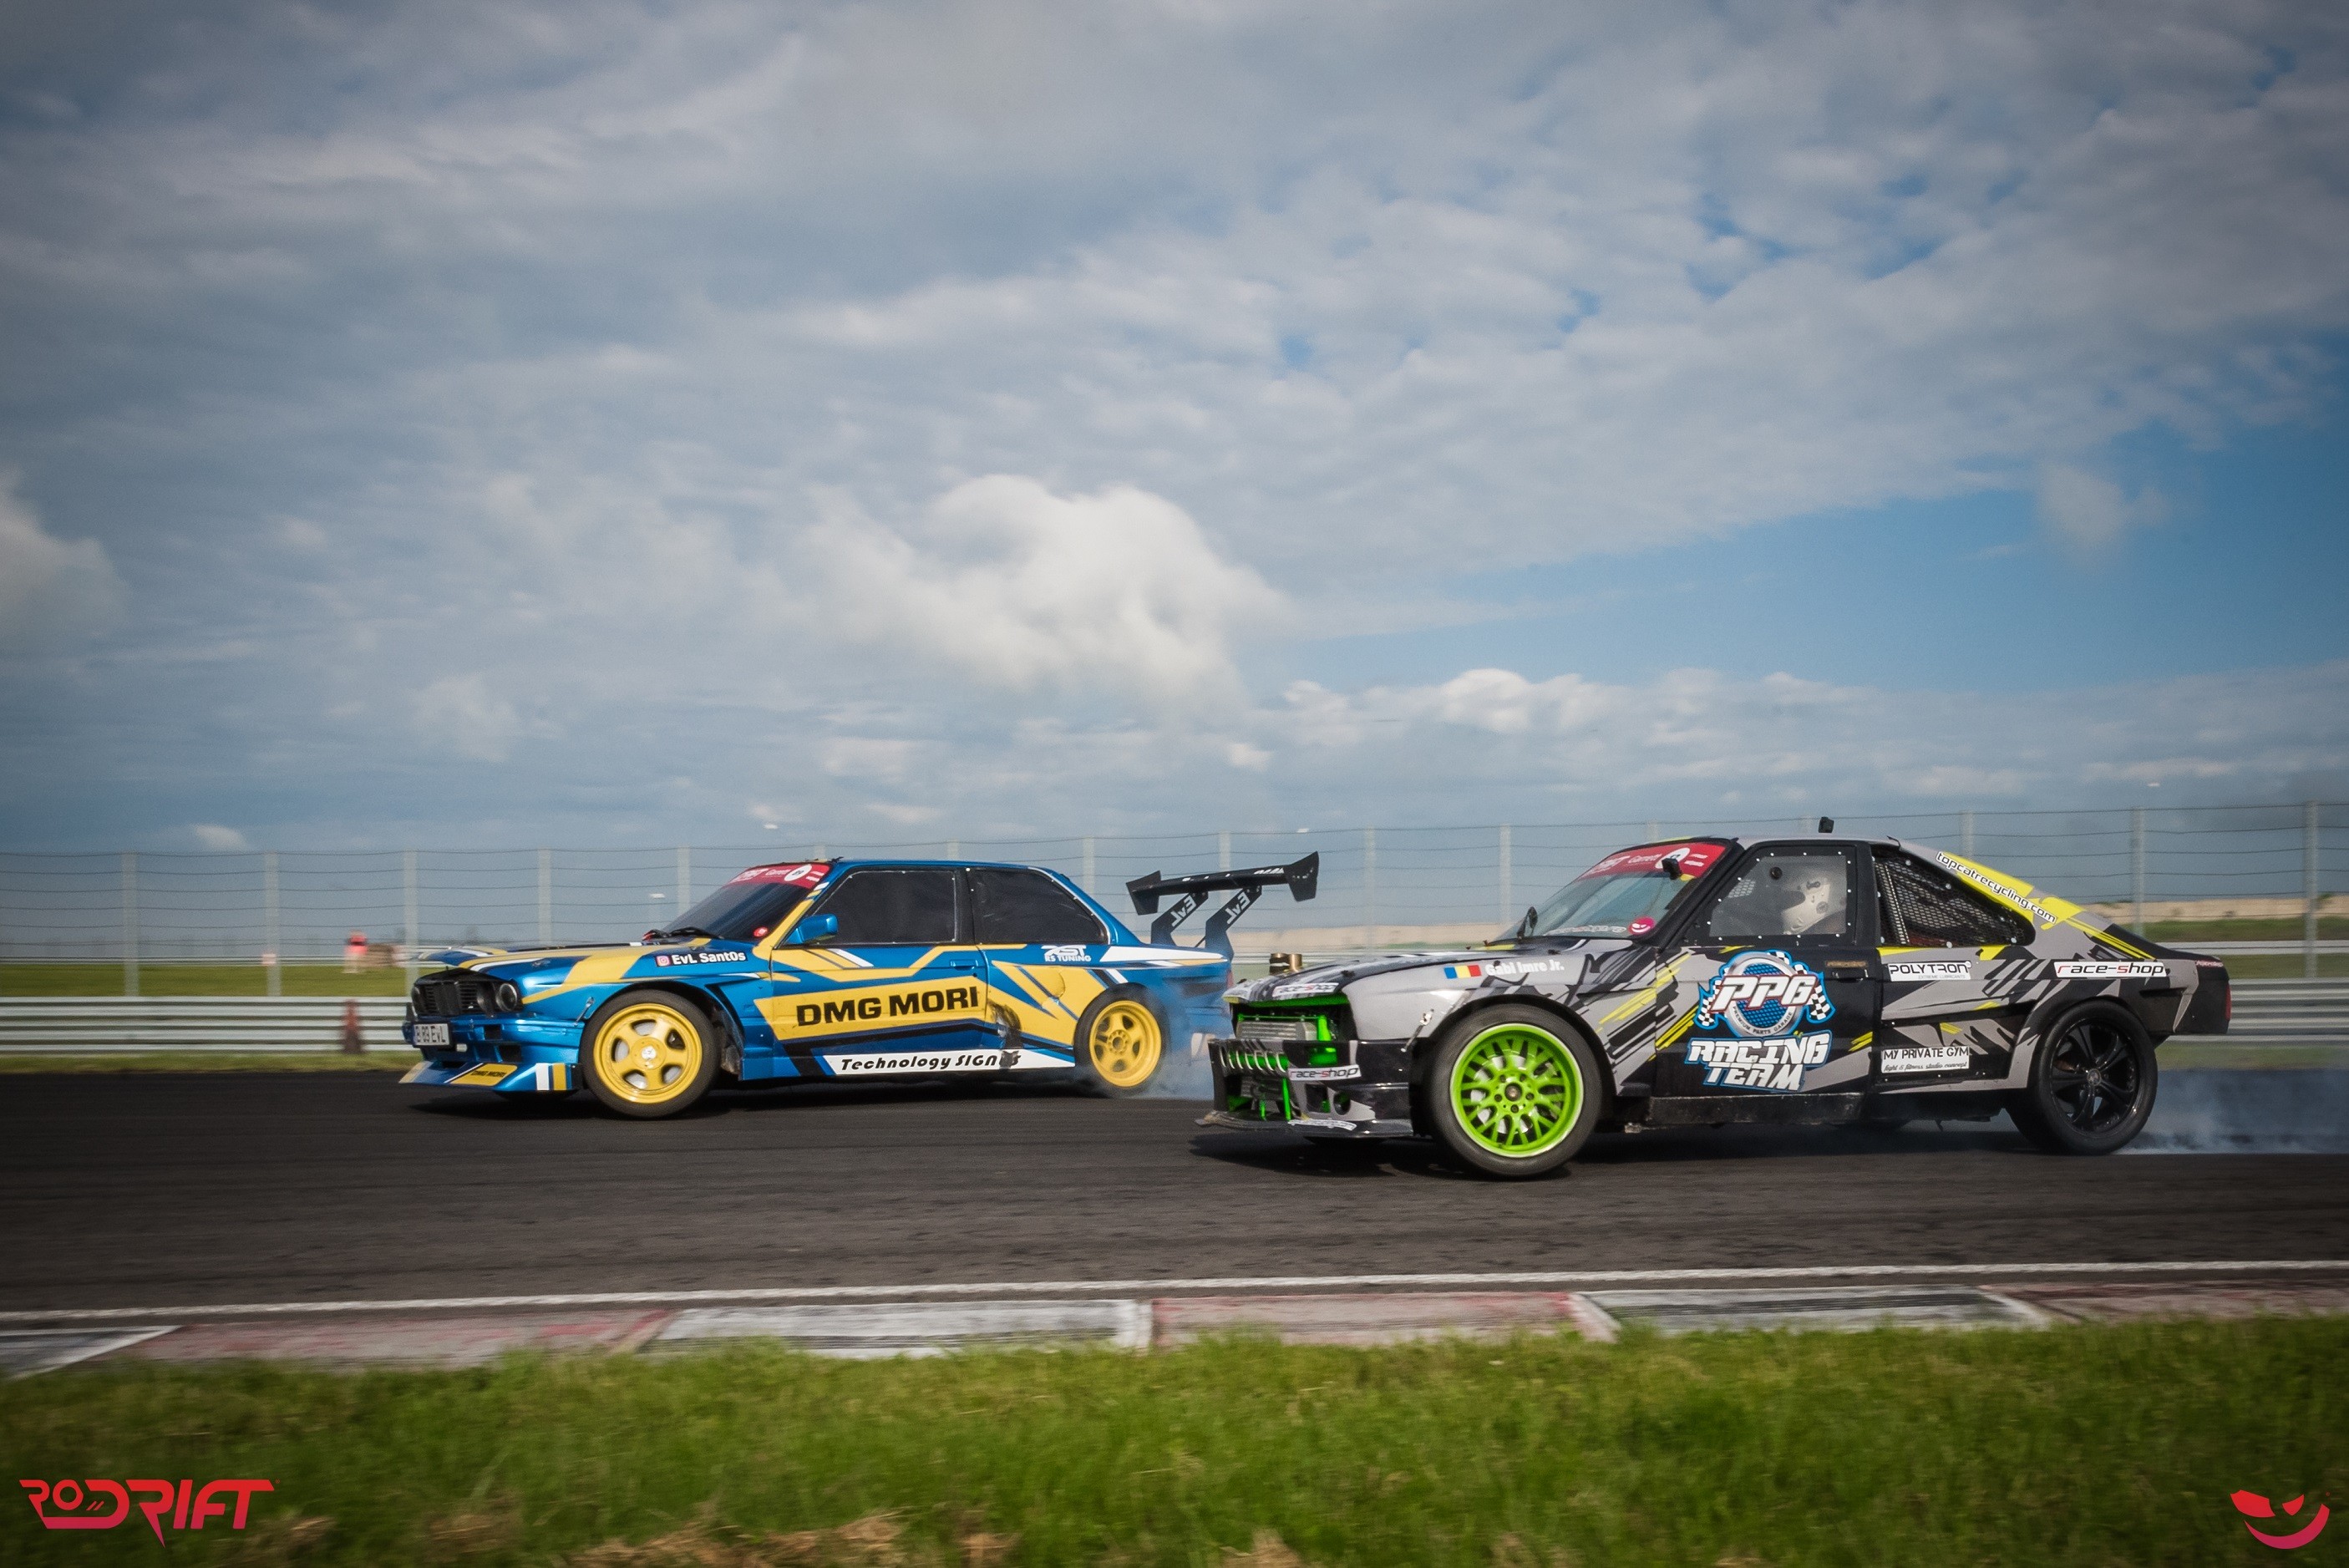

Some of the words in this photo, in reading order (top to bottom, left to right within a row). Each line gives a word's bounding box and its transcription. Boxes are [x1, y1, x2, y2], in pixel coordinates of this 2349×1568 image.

[1936, 852, 2057, 922] topcatrecycling.com
[1889, 963, 1969, 975] POLYTRON
[2057, 962, 2164, 977] race-shop
[1709, 976, 1818, 1012] PPG
[796, 997, 882, 1027] DMG
[888, 986, 979, 1017] MORI
[1687, 1033, 1829, 1065] RACING
[1884, 1049, 1899, 1060] MY
[1901, 1048, 1943, 1059] PRIVATE
[1946, 1047, 1969, 1057] GYM
[841, 1055, 951, 1071] Technology
[955, 1054, 1022, 1067] SIGNS
[1290, 1068, 1359, 1078] race-shop
[1707, 1063, 1804, 1091] TEAM
